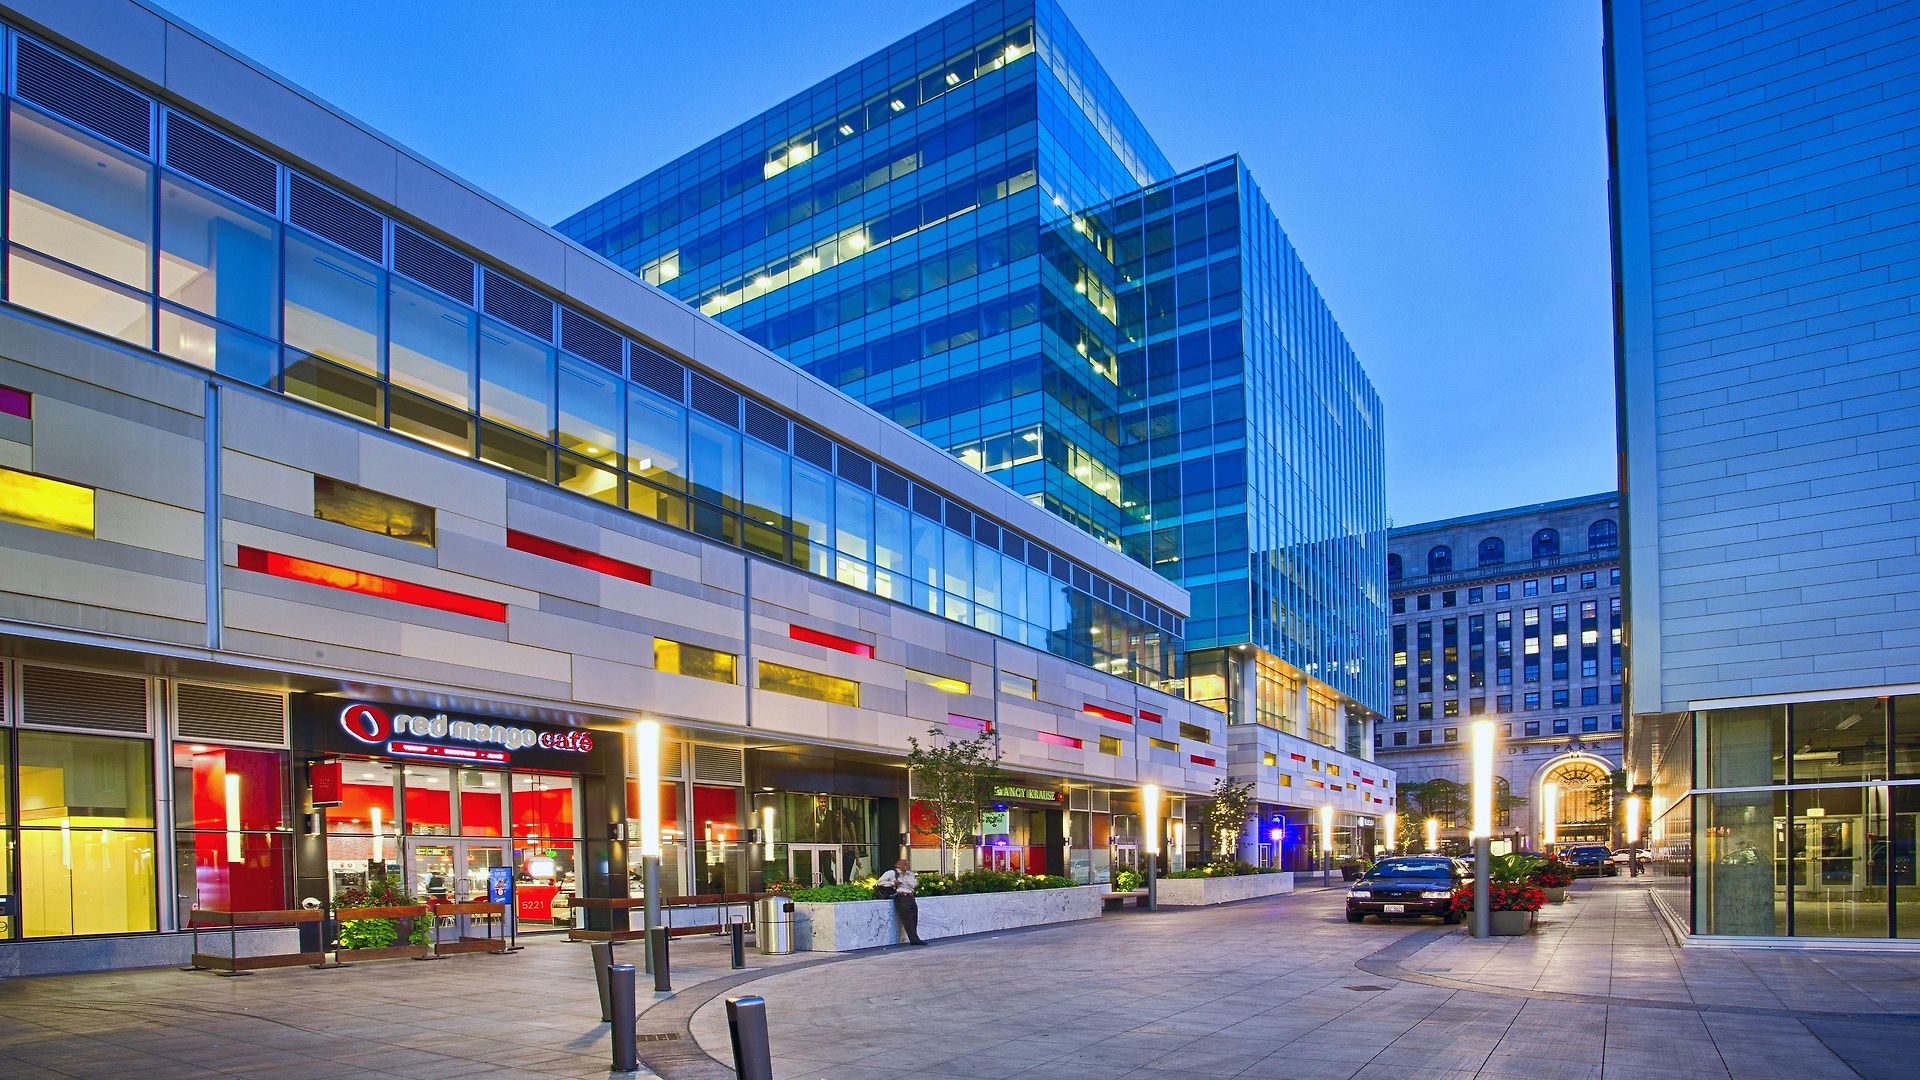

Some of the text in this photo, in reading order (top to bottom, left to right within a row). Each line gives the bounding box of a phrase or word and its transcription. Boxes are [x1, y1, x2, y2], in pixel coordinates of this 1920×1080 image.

[394, 714, 593, 752] red mango café
[1552, 741, 1601, 752] PARK
[1029, 789, 1056, 800] KRAUSE
[522, 900, 544, 910] 5221
